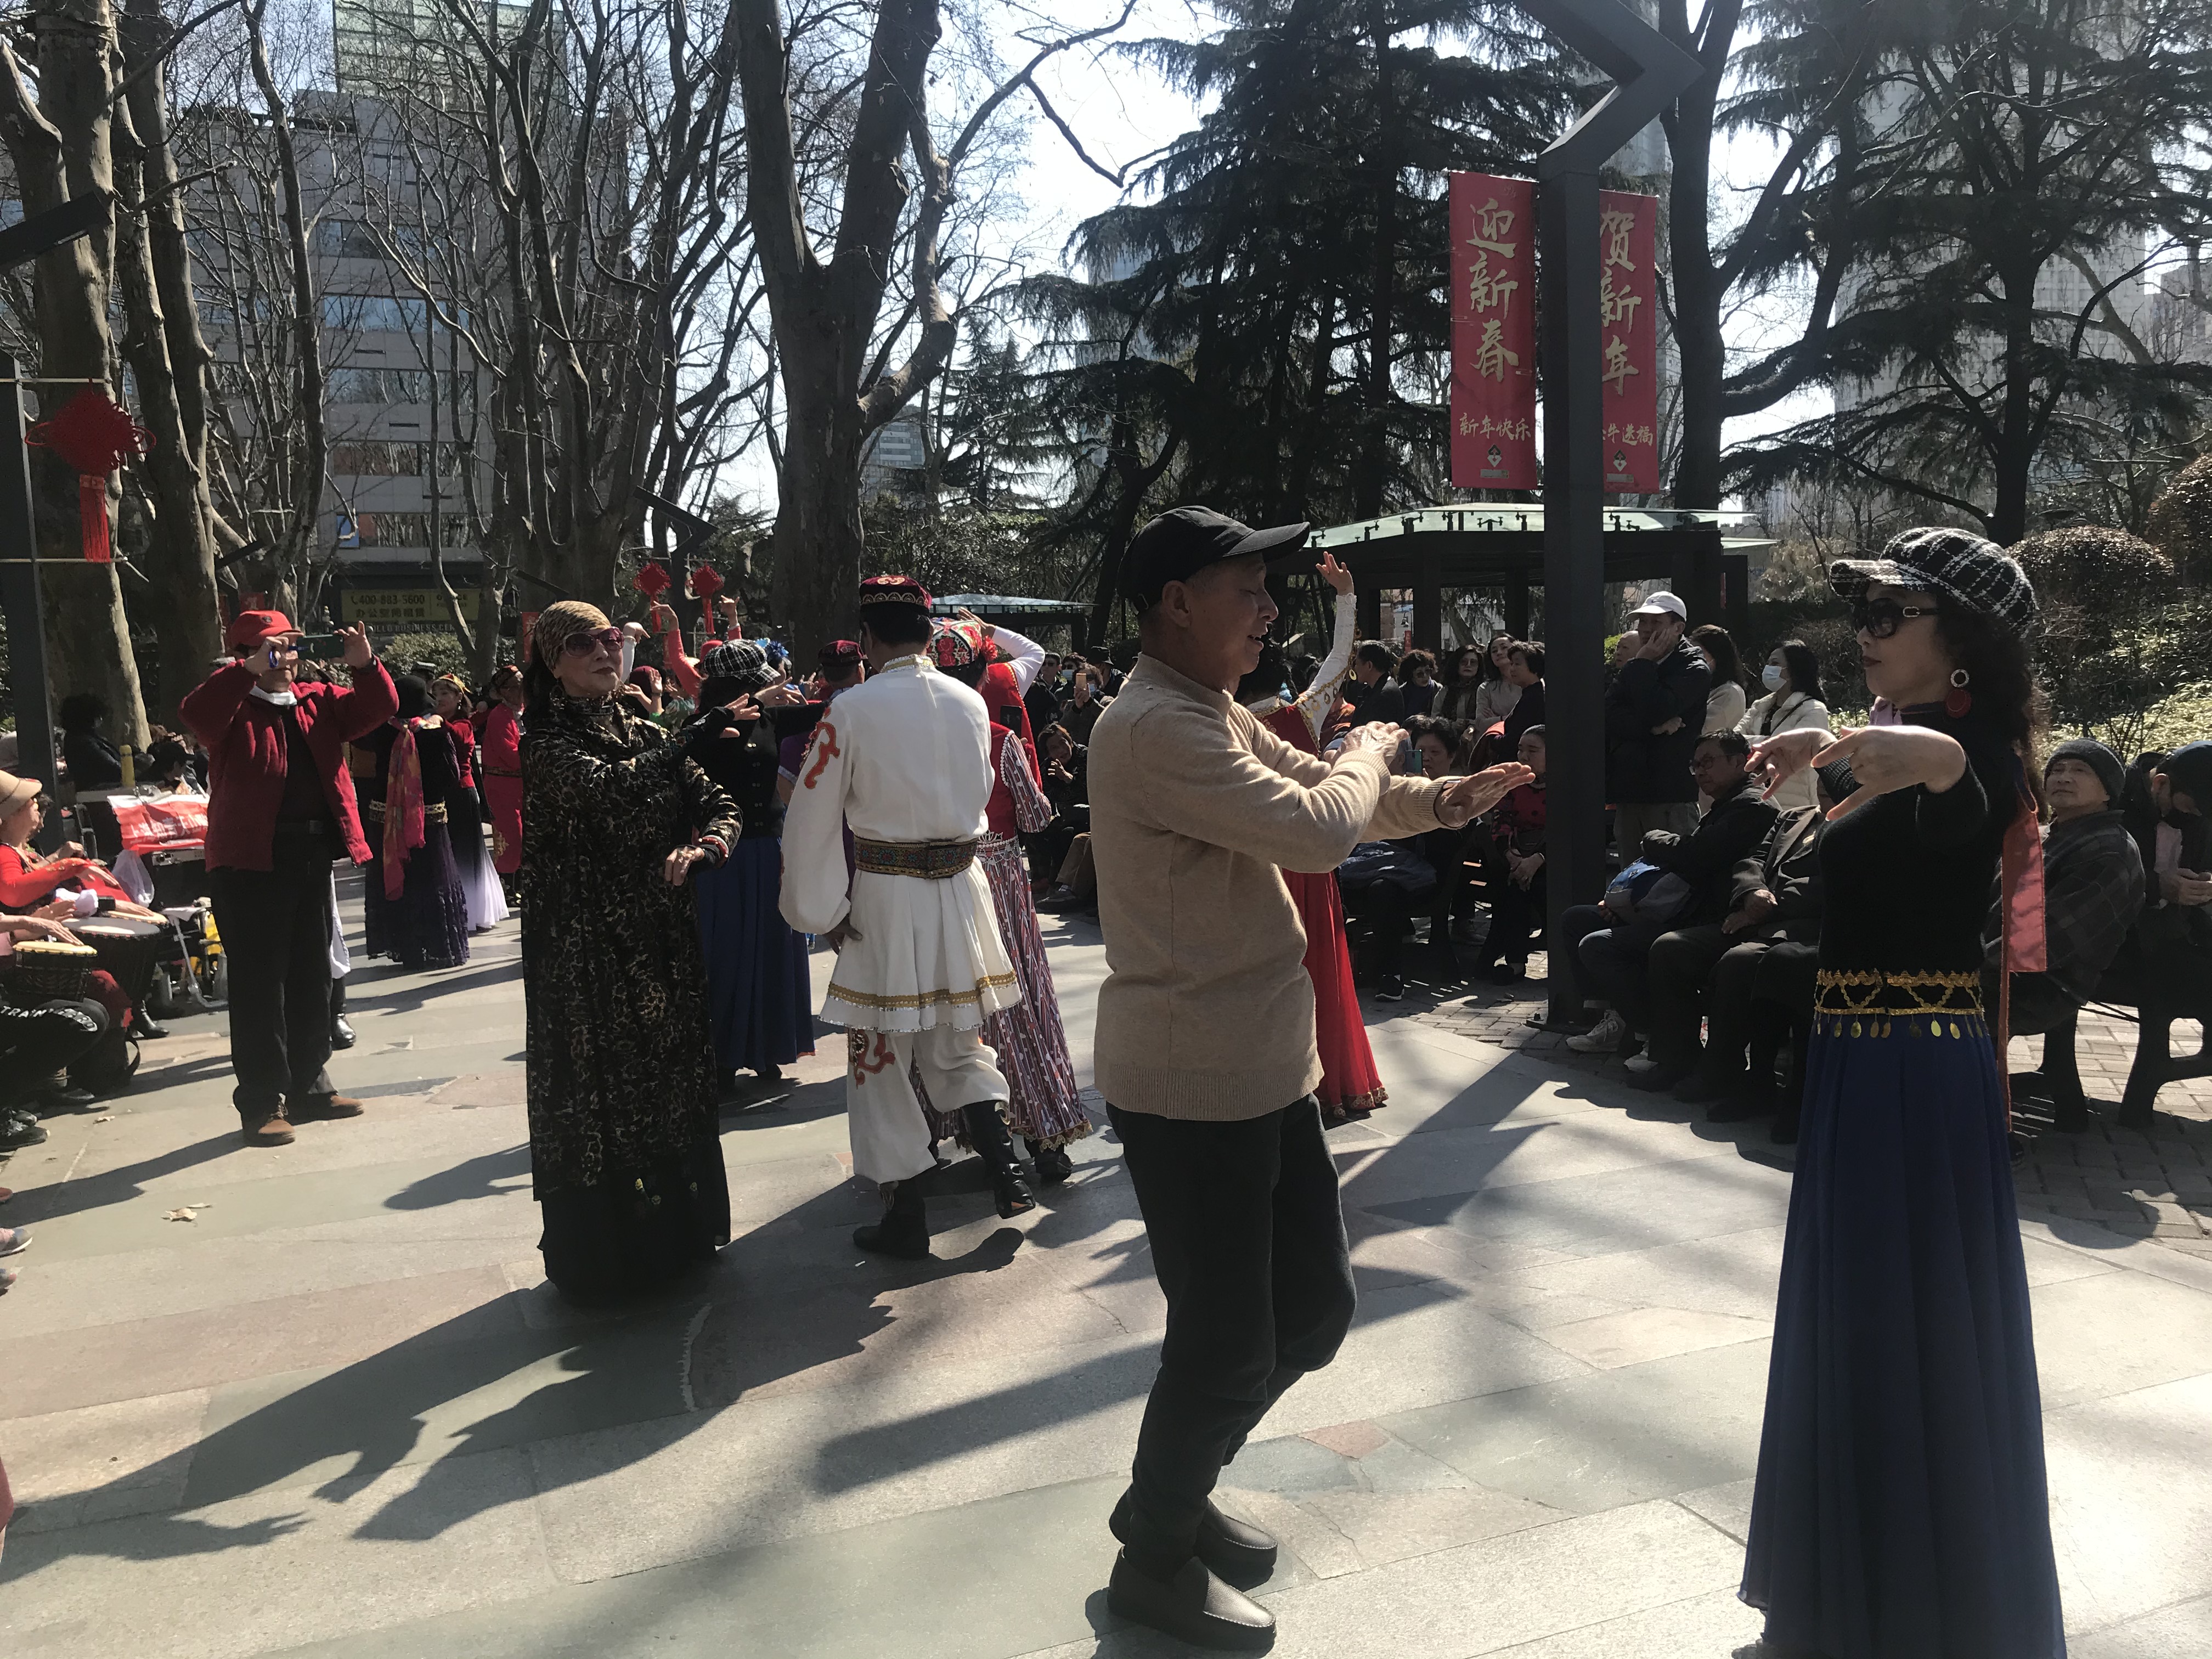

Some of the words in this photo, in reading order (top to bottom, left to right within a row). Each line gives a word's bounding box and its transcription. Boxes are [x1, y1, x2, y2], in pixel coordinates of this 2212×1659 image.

[1466, 198, 1518, 382] 迎新春
[1600, 204, 1641, 396] 贺新年
[1459, 413, 1532, 441] 新年快乐
[1602, 423, 1654, 447] 牛送福
